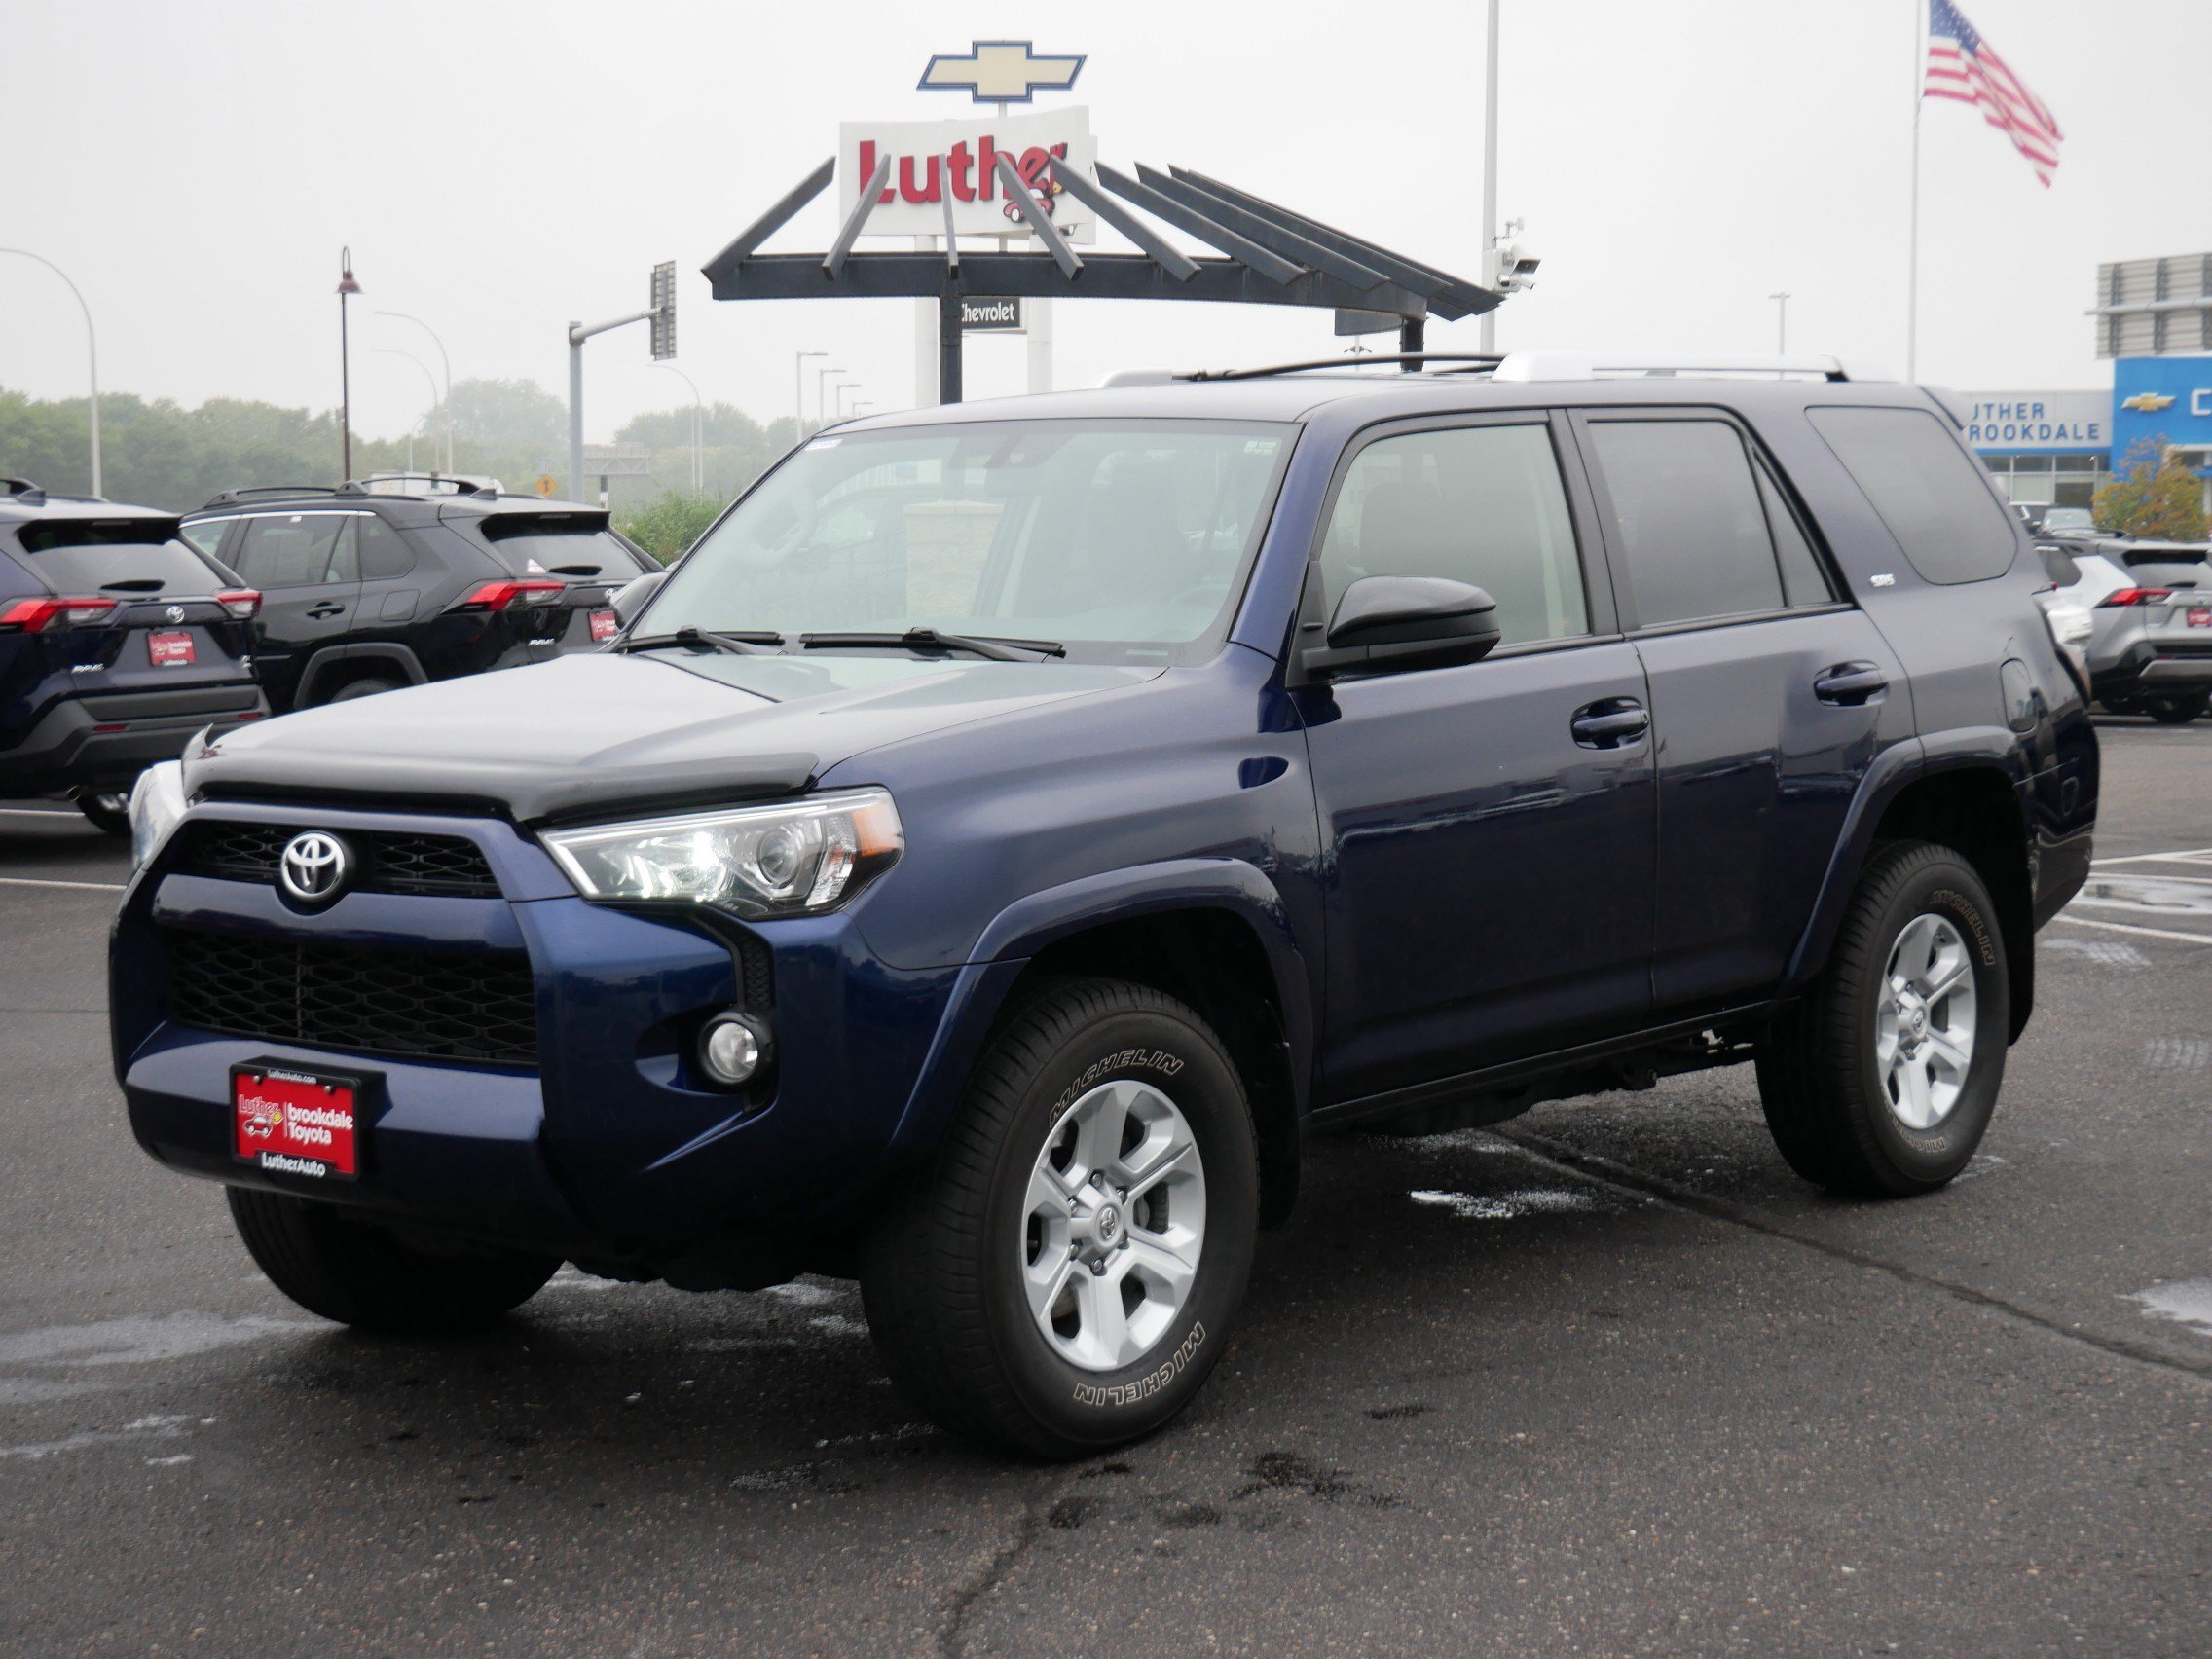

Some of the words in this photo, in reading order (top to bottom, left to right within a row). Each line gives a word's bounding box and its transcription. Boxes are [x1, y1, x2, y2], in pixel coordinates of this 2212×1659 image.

[859, 134, 1068, 203] Luther
[1969, 423, 2100, 441] ROOKDALE
[1048, 1049, 1185, 1127] MICHELIN
[238, 1094, 279, 1115] Luther
[288, 1102, 353, 1129] brookdale
[288, 1121, 333, 1145] Toyota
[261, 1151, 326, 1177] LutherAuto
[1073, 1320, 1206, 1407] MICHELIN
